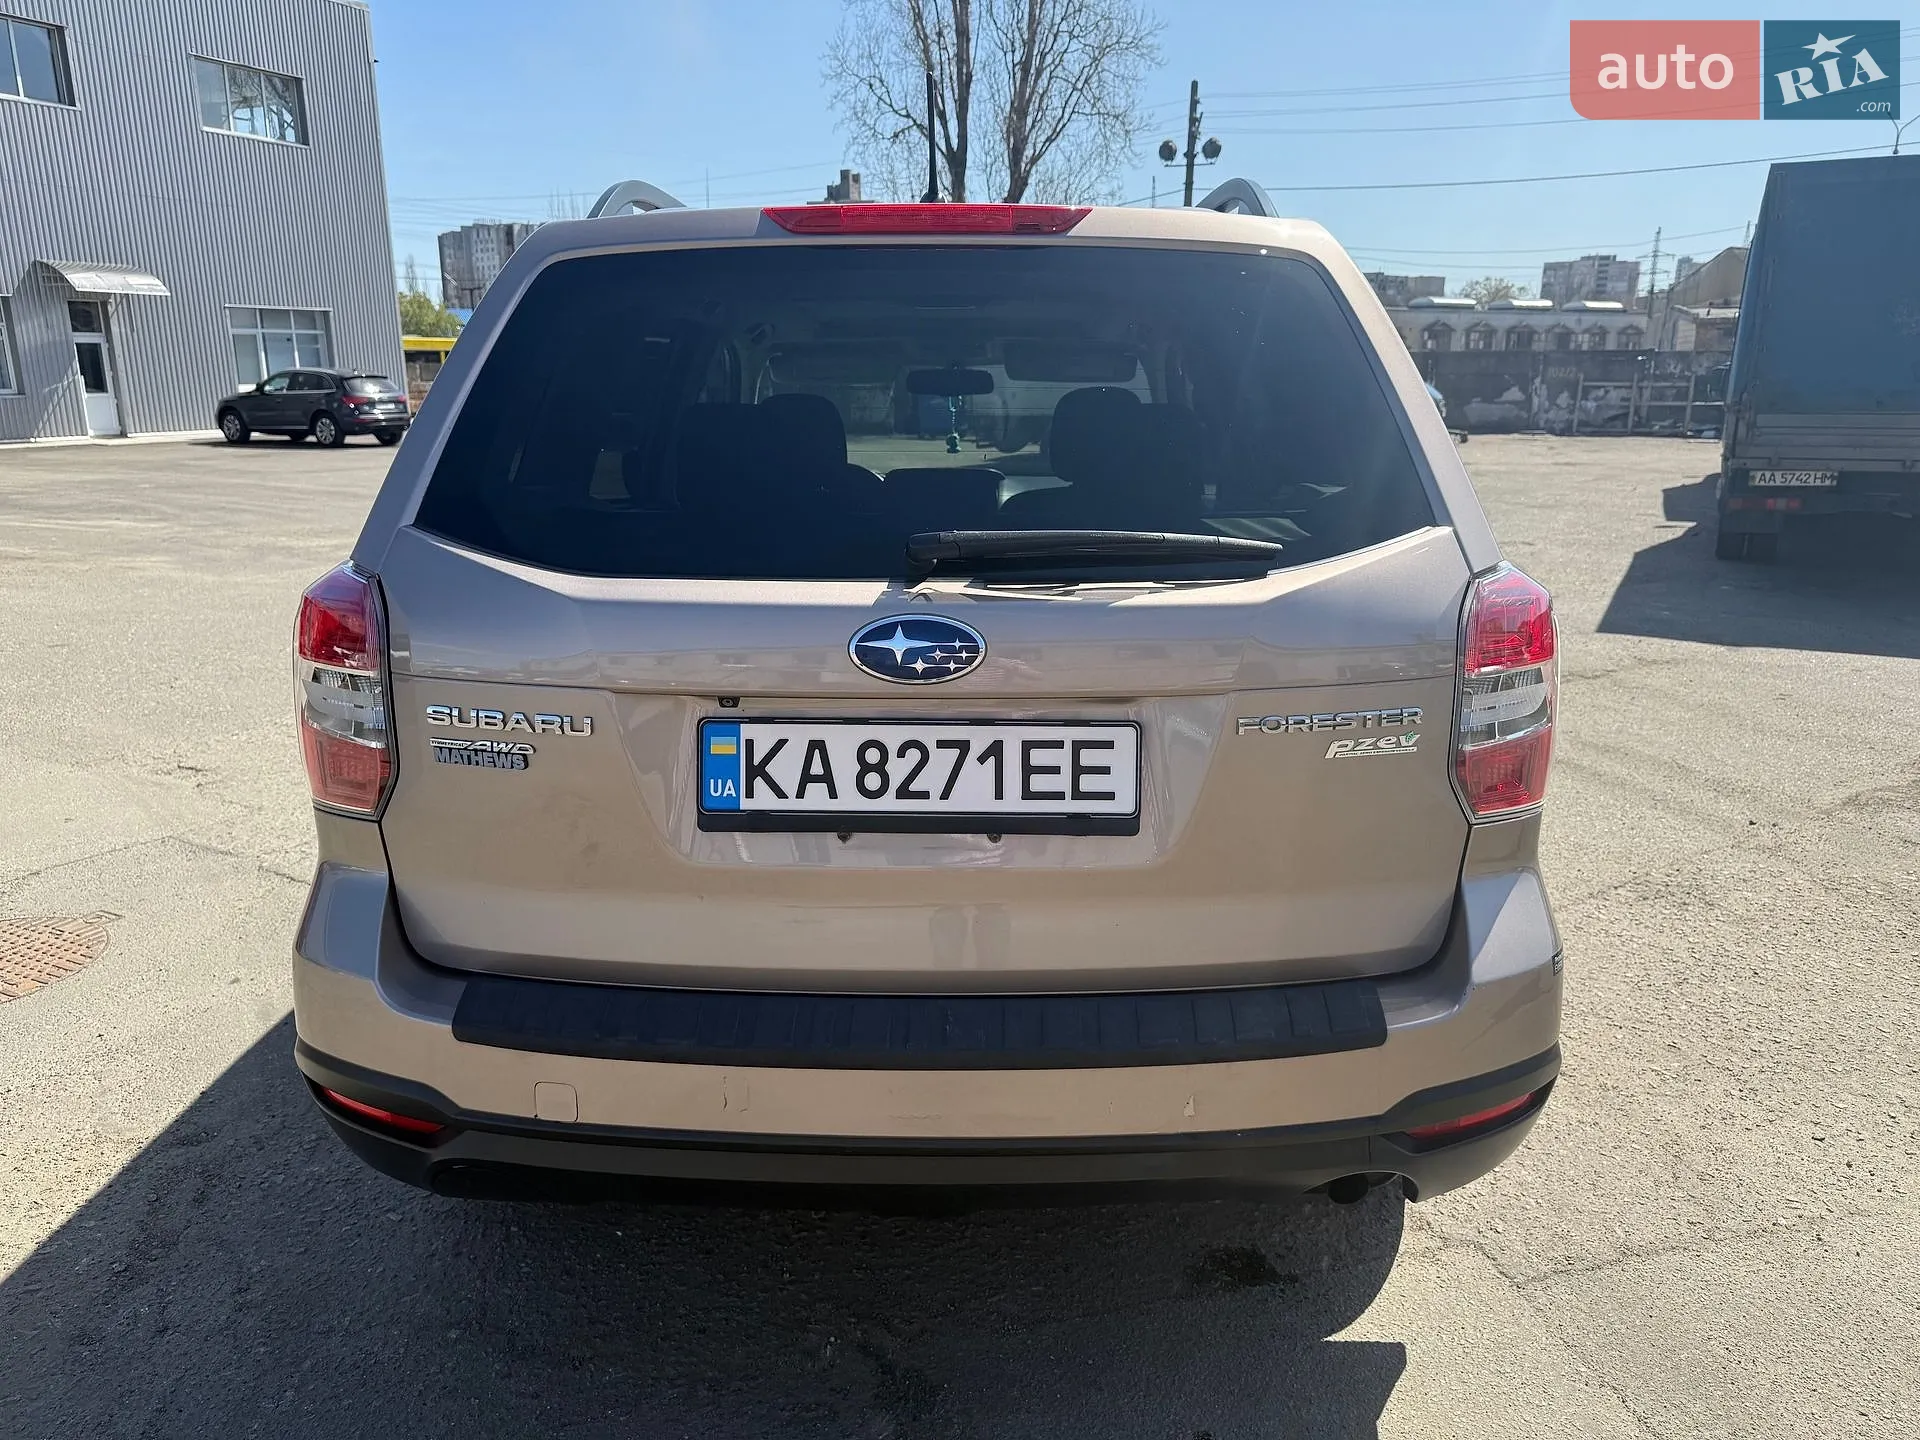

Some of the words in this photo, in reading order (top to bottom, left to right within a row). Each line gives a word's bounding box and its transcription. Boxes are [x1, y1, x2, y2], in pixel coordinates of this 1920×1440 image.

[1757, 472, 1777, 484] AA
[1780, 472, 1811, 485] 5742
[426, 704, 593, 737] SUBARU
[1236, 706, 1424, 736] FORESTER
[434, 747, 529, 770] MATHEWS
[467, 739, 536, 755] AWD
[744, 738, 839, 800] KA
[855, 738, 1004, 801] 8271
[1020, 739, 1116, 801] EE
[709, 778, 736, 798] UA
